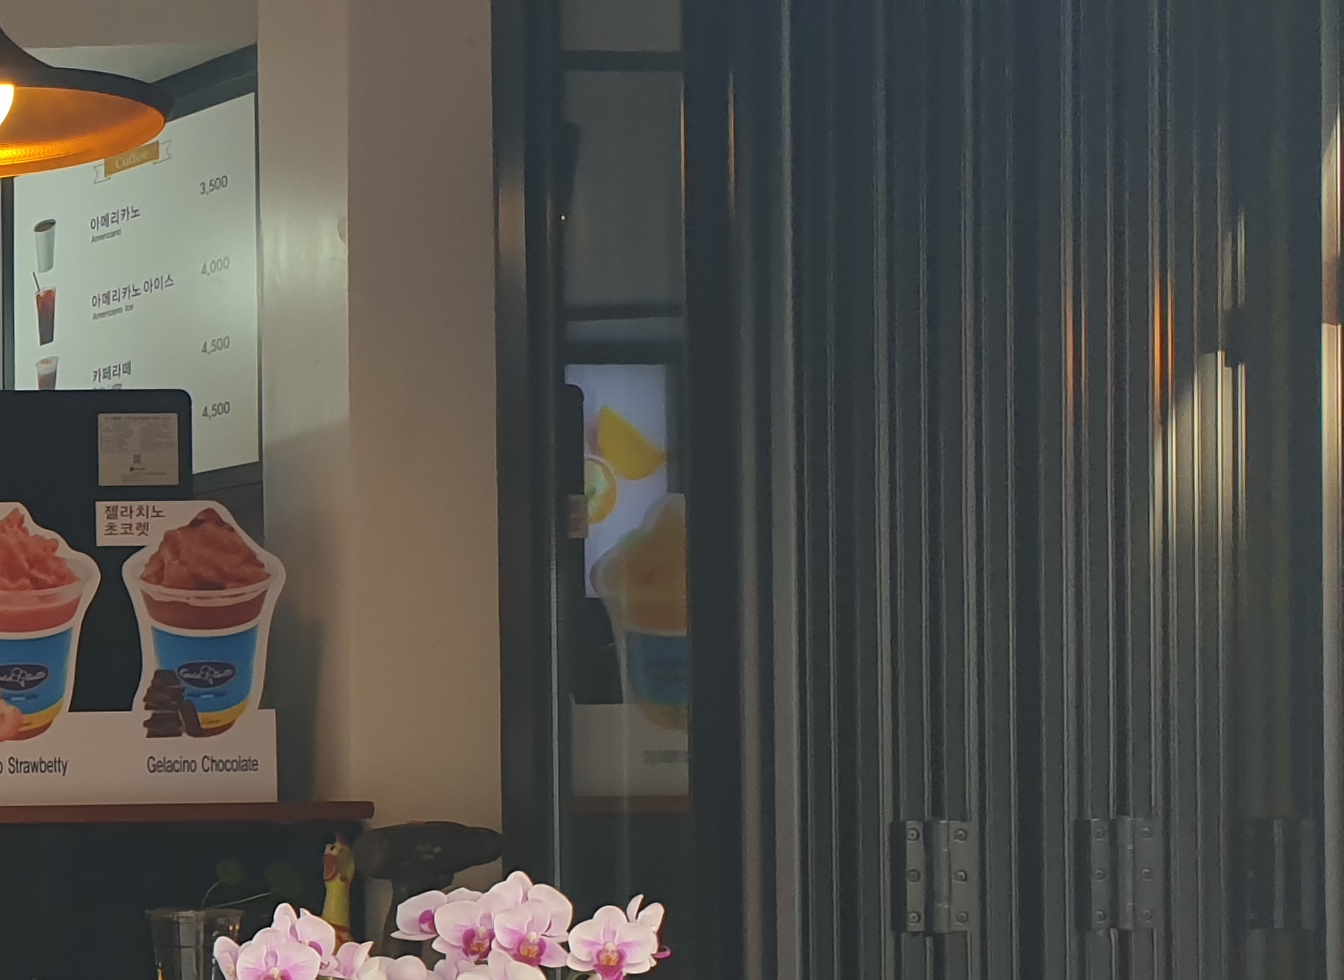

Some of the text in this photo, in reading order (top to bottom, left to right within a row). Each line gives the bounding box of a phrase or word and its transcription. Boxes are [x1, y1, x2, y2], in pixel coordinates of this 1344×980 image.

[199, 175, 228, 195] 3,500
[90, 205, 141, 231] 아메리카노
[201, 256, 230, 276] 4,000
[91, 273, 175, 308] 아메리카노 아이스
[201, 336, 230, 355] 4,500
[202, 401, 231, 420] 4,500
[104, 505, 166, 520] 젤라치노
[103, 521, 150, 536] 초코렛
[147, 755, 259, 774] Gelacino Chocolate
